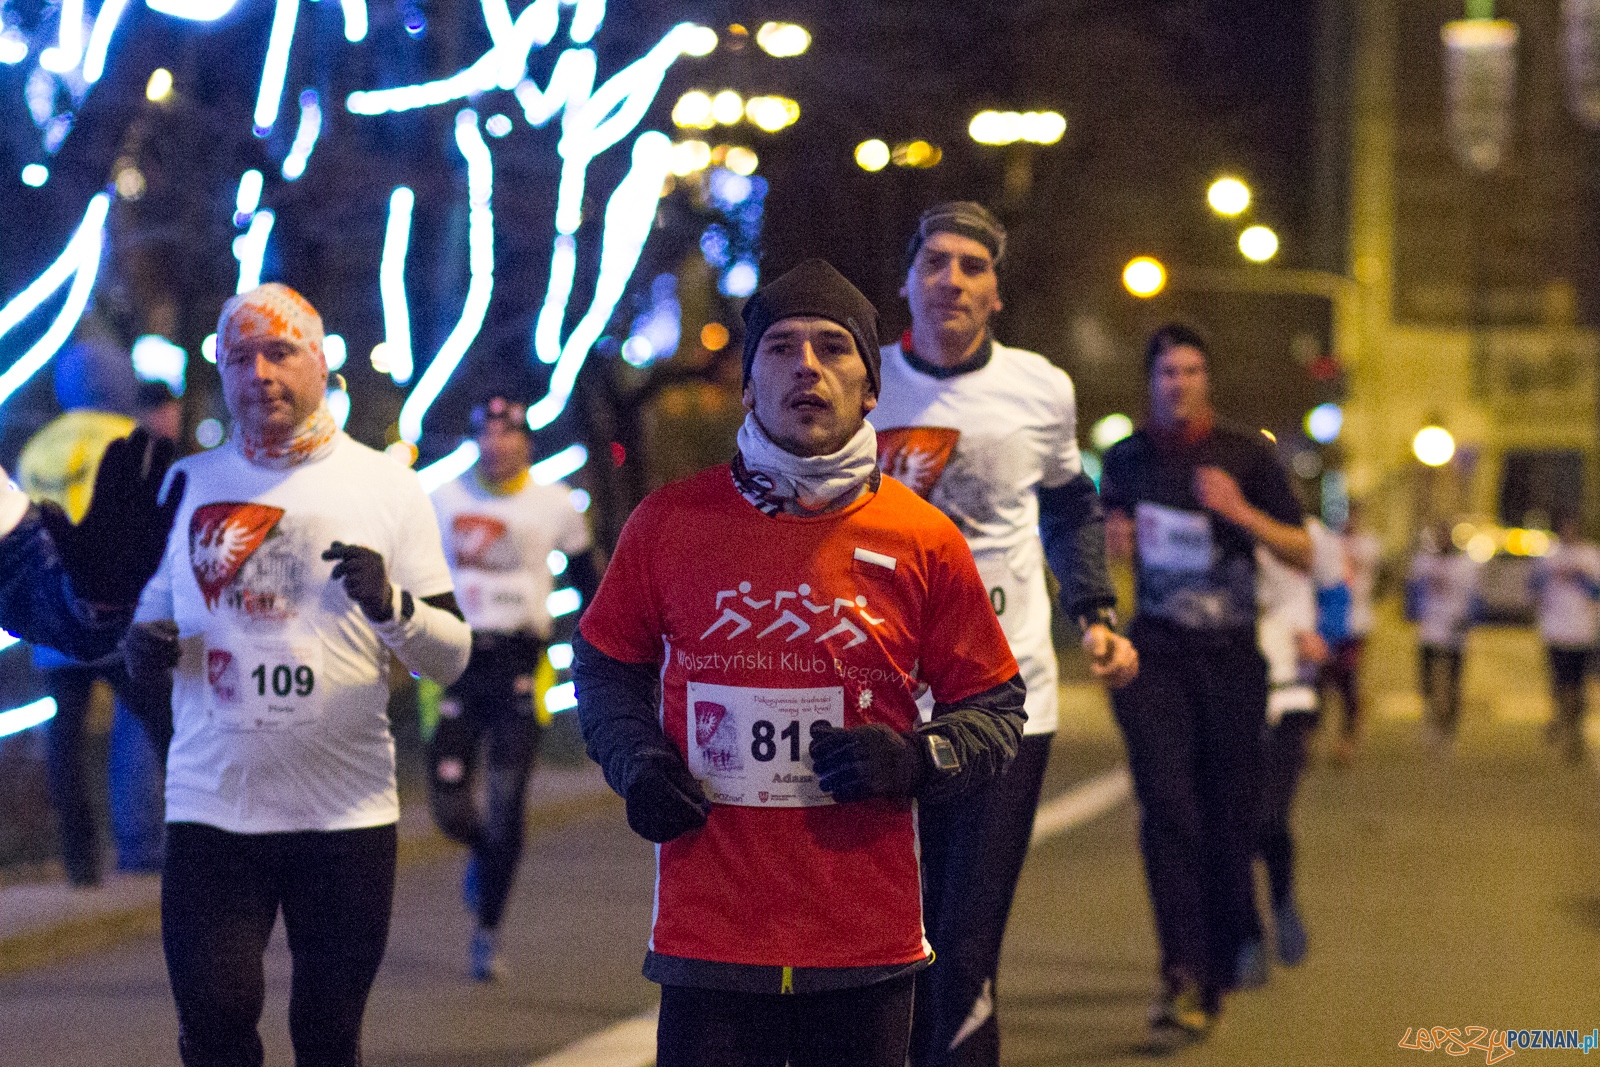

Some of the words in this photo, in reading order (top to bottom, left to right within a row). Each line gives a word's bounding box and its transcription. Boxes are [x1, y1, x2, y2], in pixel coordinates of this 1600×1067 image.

[251, 664, 315, 697] 109
[677, 651, 773, 673] Wolsztyński
[780, 652, 827, 674] Klub
[834, 658, 909, 689] Biegowy
